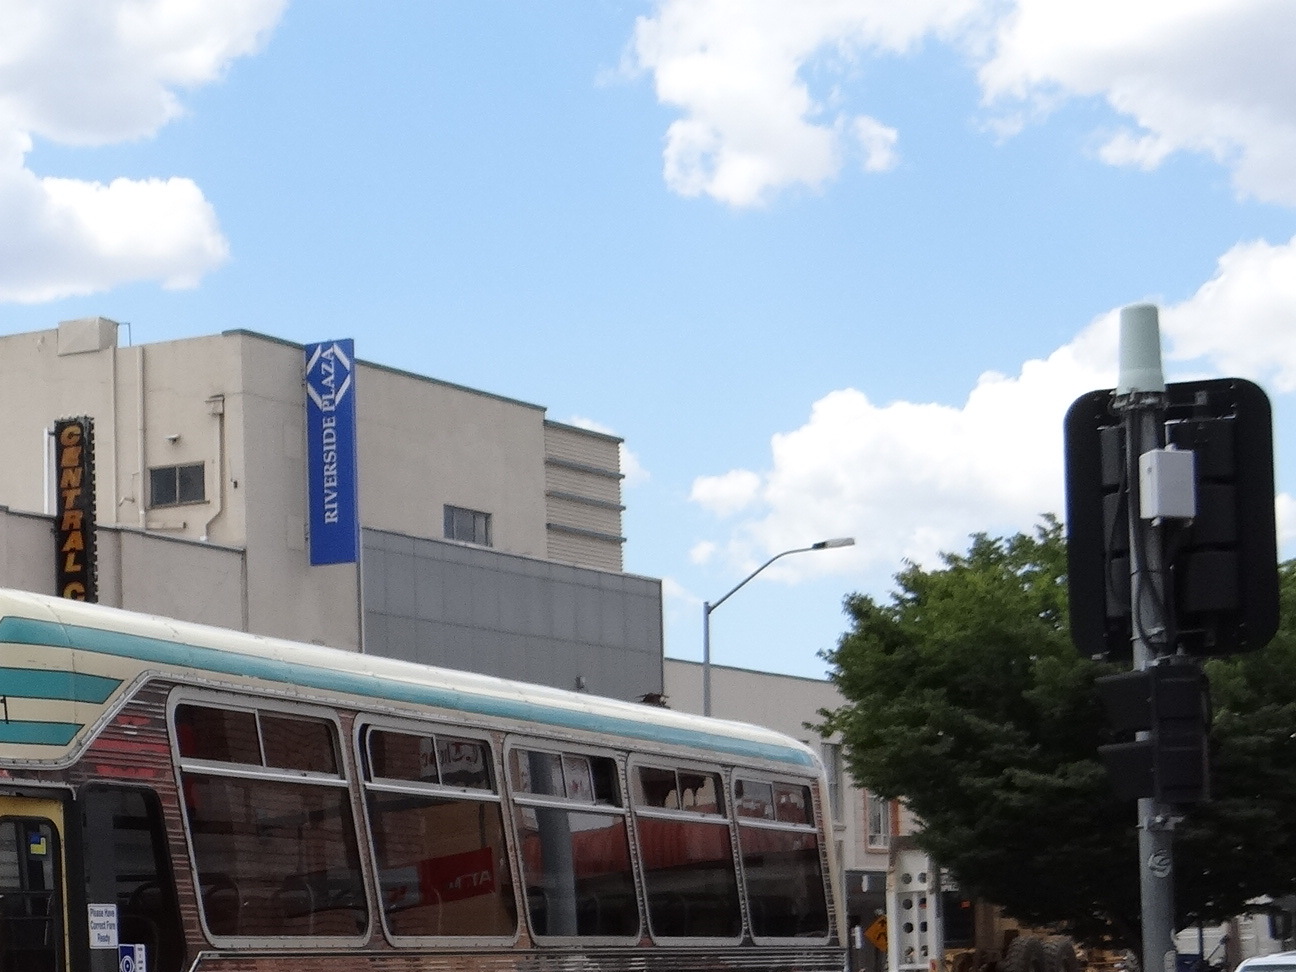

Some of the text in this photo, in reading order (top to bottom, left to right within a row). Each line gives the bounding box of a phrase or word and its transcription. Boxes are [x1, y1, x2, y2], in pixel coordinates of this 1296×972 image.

[60, 425, 85, 600] CENTRAL C
[320, 346, 338, 523] RIVERSIDE PLAZA
